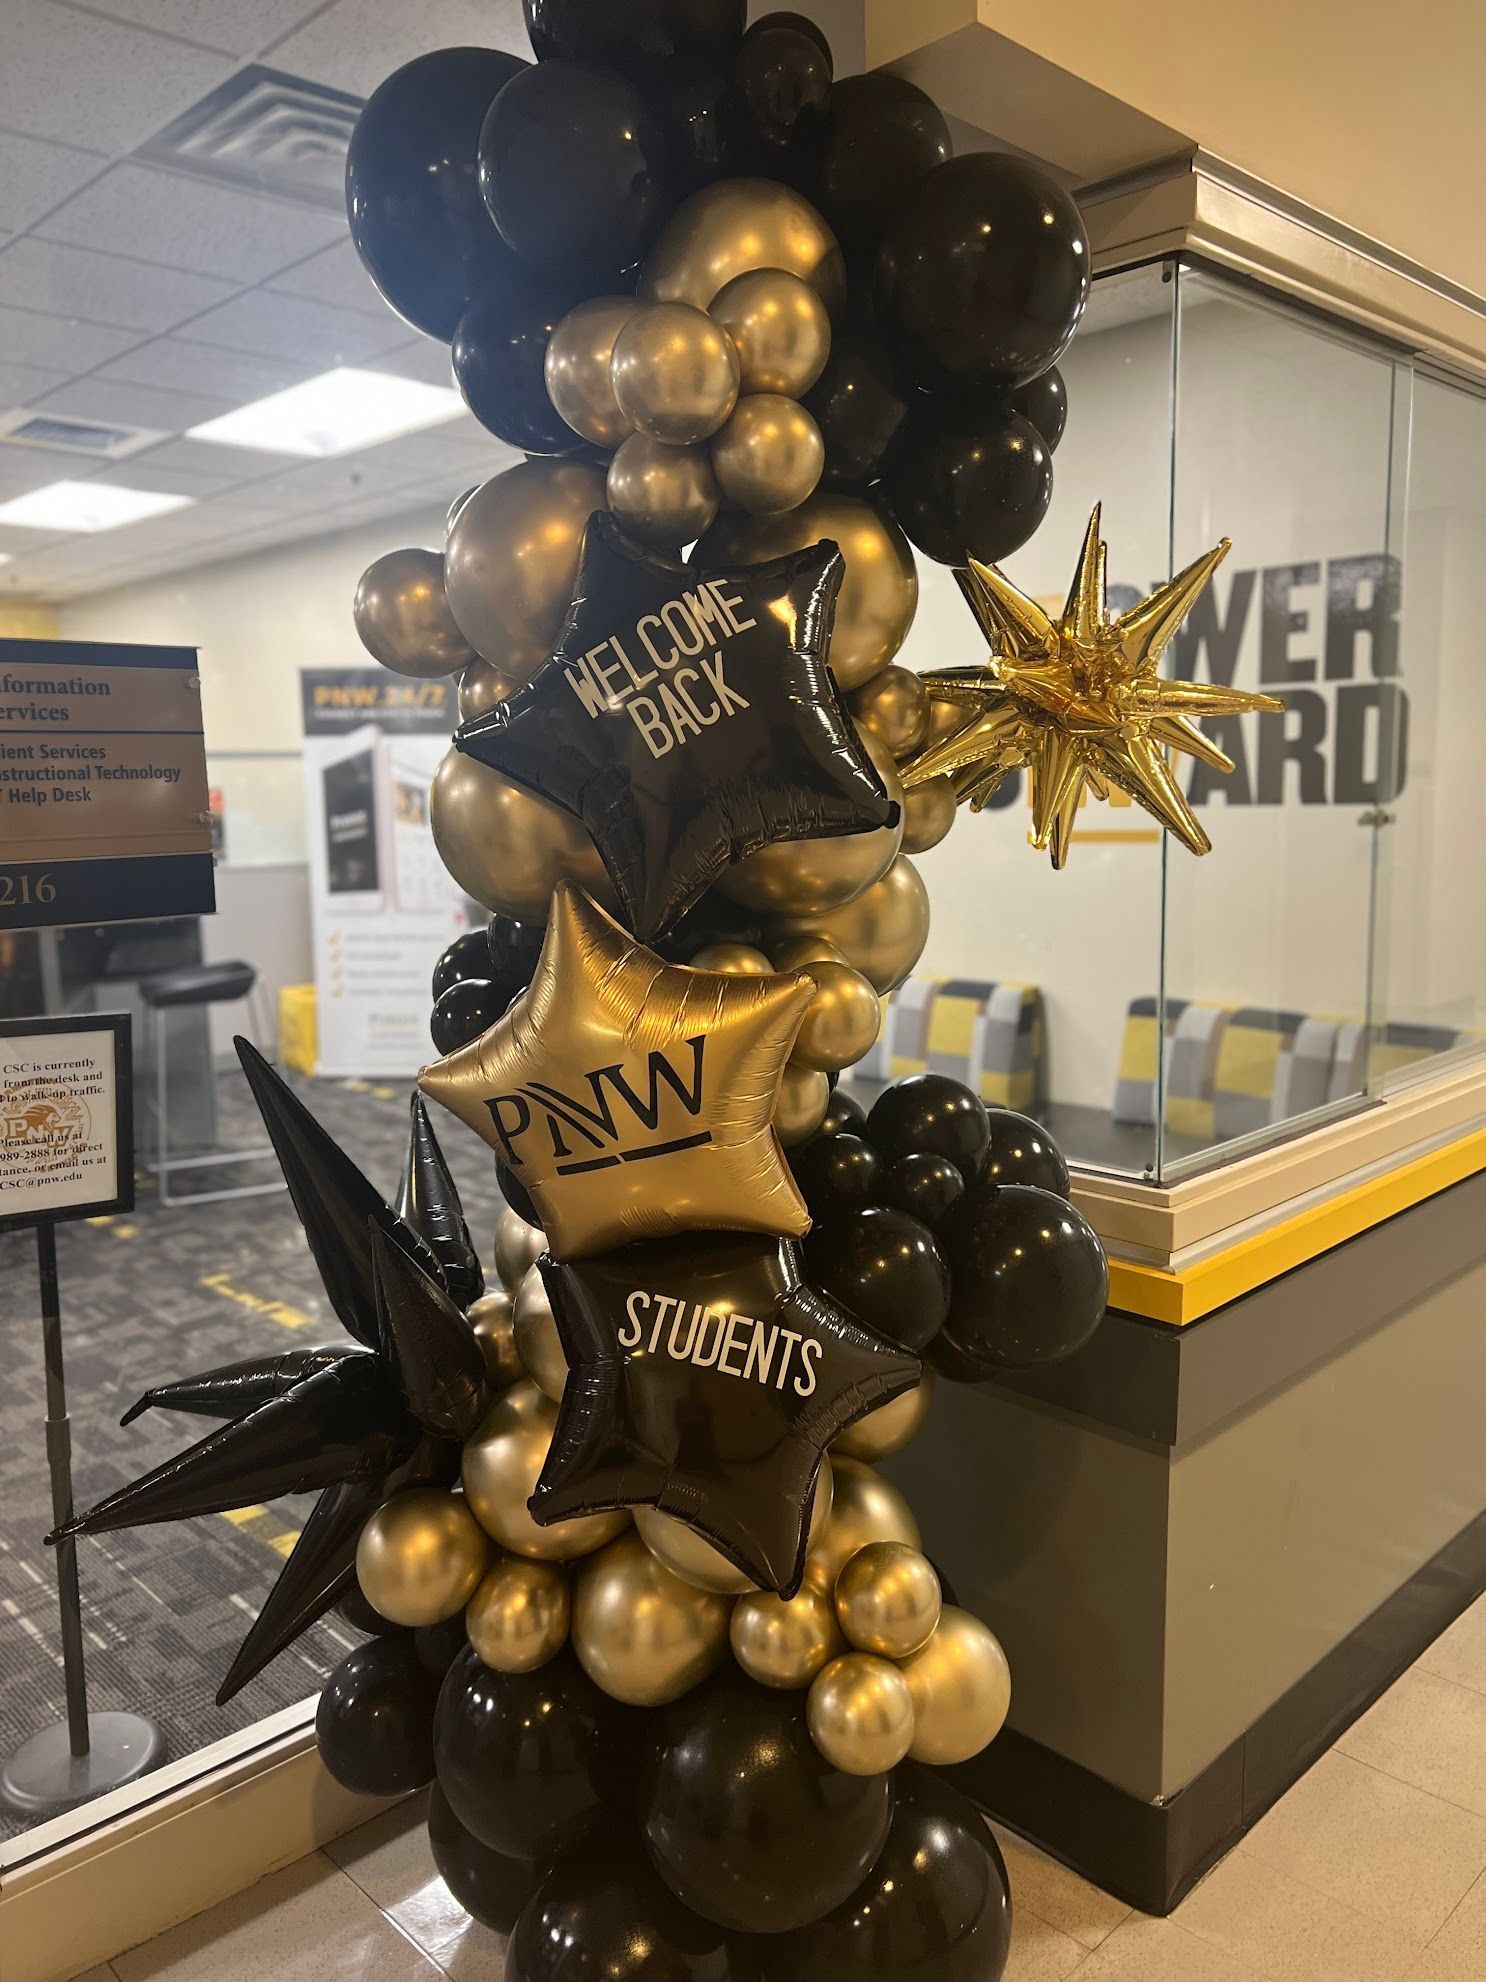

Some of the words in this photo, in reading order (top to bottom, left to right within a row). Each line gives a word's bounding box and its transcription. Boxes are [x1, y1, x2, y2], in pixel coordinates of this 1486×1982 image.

[564, 578, 757, 719] WELCOME
[0, 673, 110, 696] formation
[313, 685, 378, 708] PNW
[626, 650, 750, 758] BACK
[39, 744, 106, 759] Services
[0, 765, 91, 781] structional
[95, 764, 181, 782] Technology
[9, 787, 47, 806] Help
[53, 787, 92, 802] Desk
[3, 1063, 30, 1074] CSC
[33, 1062, 42, 1072] is
[44, 1058, 95, 1071] currently
[4, 1078, 31, 1088] from
[35, 1076, 53, 1085] the
[55, 1073, 80, 1084] desk
[83, 1071, 103, 1081] and
[7, 1094, 18, 1102] to
[19, 1090, 66, 1101] walk-up
[70, 1085, 105, 1097] traffic.
[483, 1034, 706, 1165] PNW
[5, 1117, 73, 1148] PNW
[35, 1133, 54, 1144] call
[57, 1134, 69, 1142] us
[72, 1132, 82, 1140] at
[53, 1147, 69, 1156] for
[72, 1143, 103, 1154] direct
[34, 1164, 47, 1172] or
[49, 1159, 79, 1171] email
[82, 1158, 94, 1166] us
[97, 1156, 107, 1164] at
[0, 1172, 82, 1190] CSC@pnw.edu
[618, 1290, 823, 1397] STUDENTS
